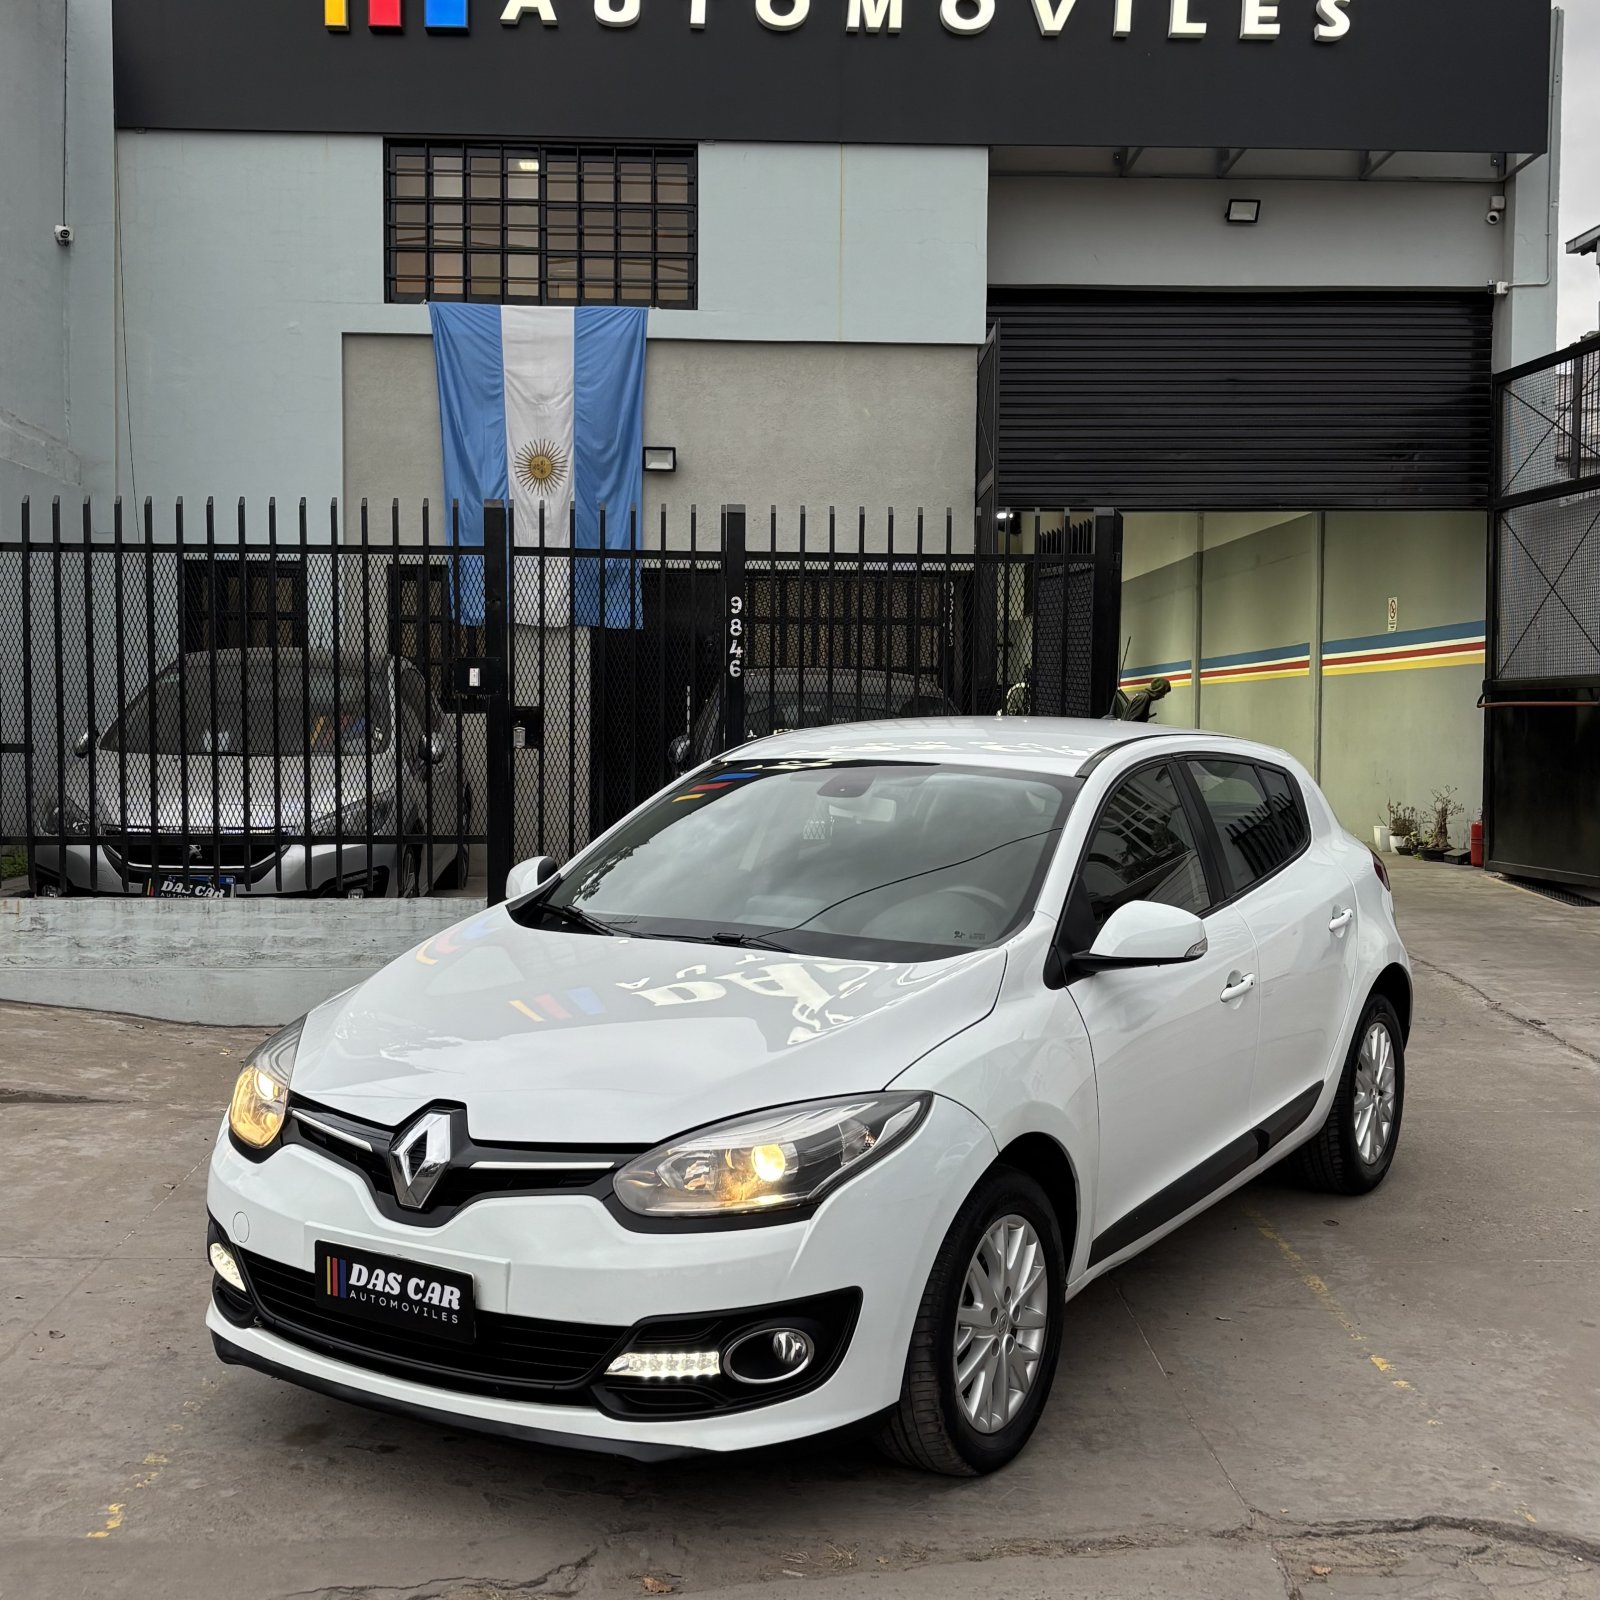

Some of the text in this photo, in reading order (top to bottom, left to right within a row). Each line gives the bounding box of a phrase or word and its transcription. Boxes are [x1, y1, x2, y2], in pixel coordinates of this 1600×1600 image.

[729, 596, 743, 677] 9846
[349, 1263, 461, 1310] DAS CAR
[349, 1289, 458, 1324] AUTOMOVILES
